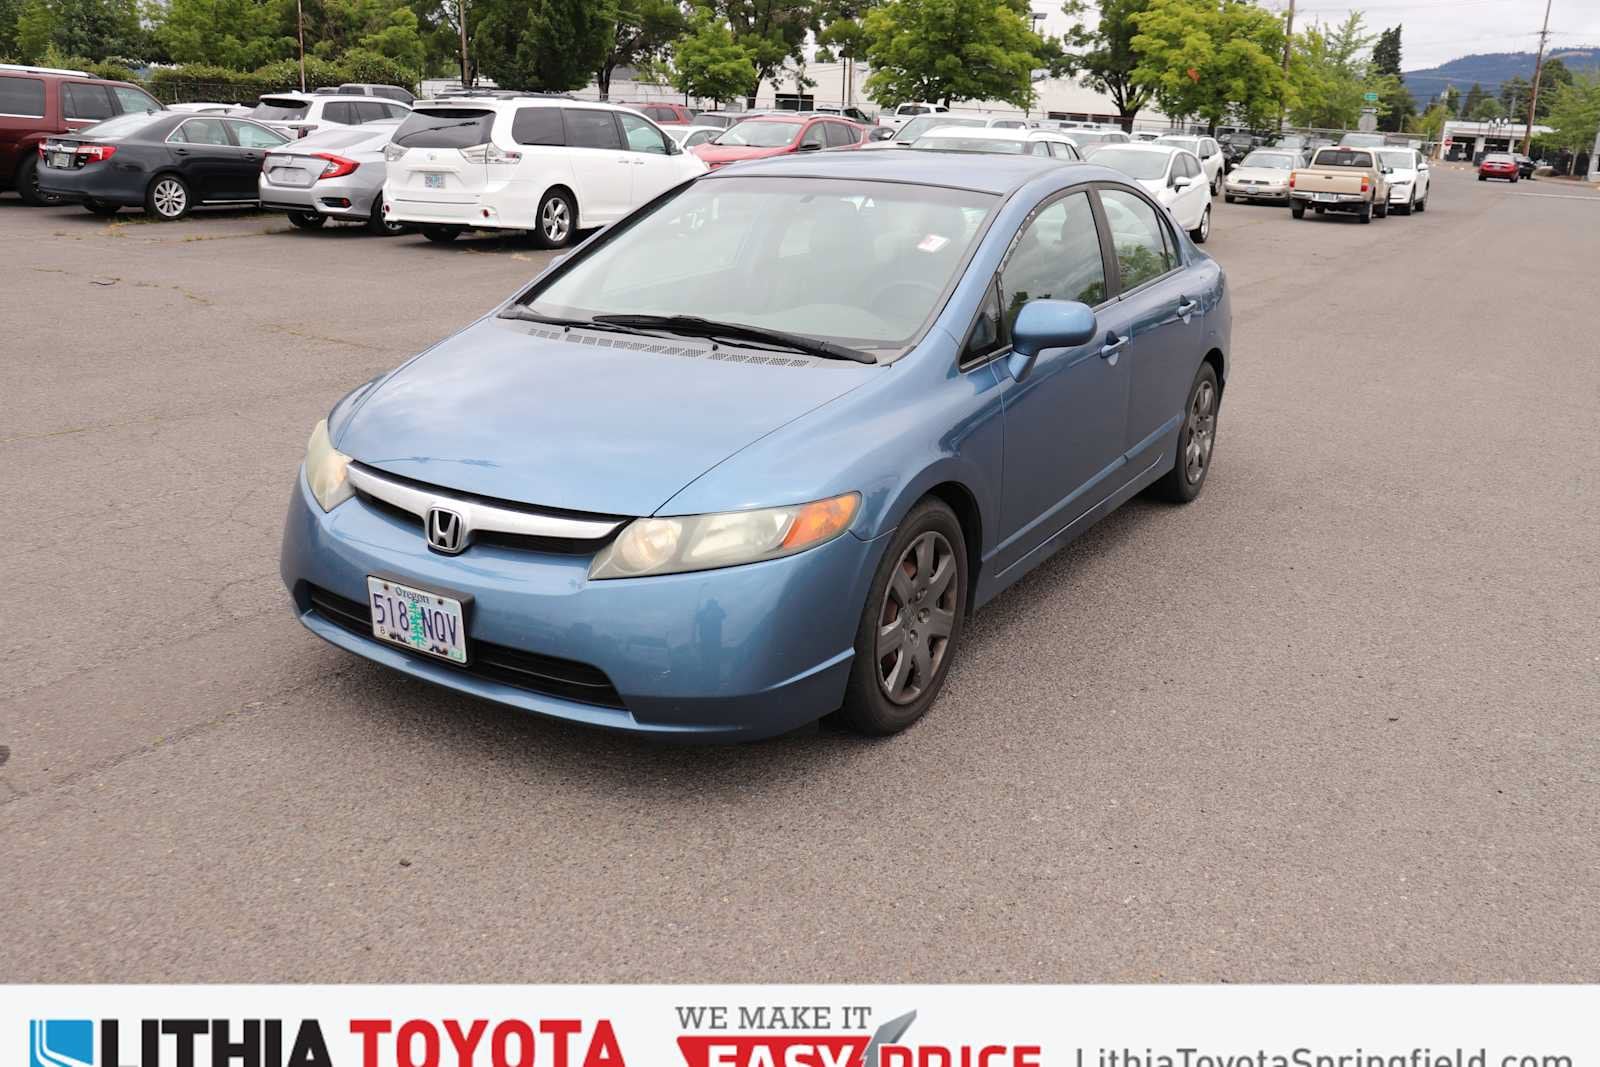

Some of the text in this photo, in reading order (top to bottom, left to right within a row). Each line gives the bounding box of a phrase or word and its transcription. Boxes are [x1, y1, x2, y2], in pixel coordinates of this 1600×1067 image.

[395, 586, 430, 604] Oregon
[373, 593, 456, 646] 518 NQV
